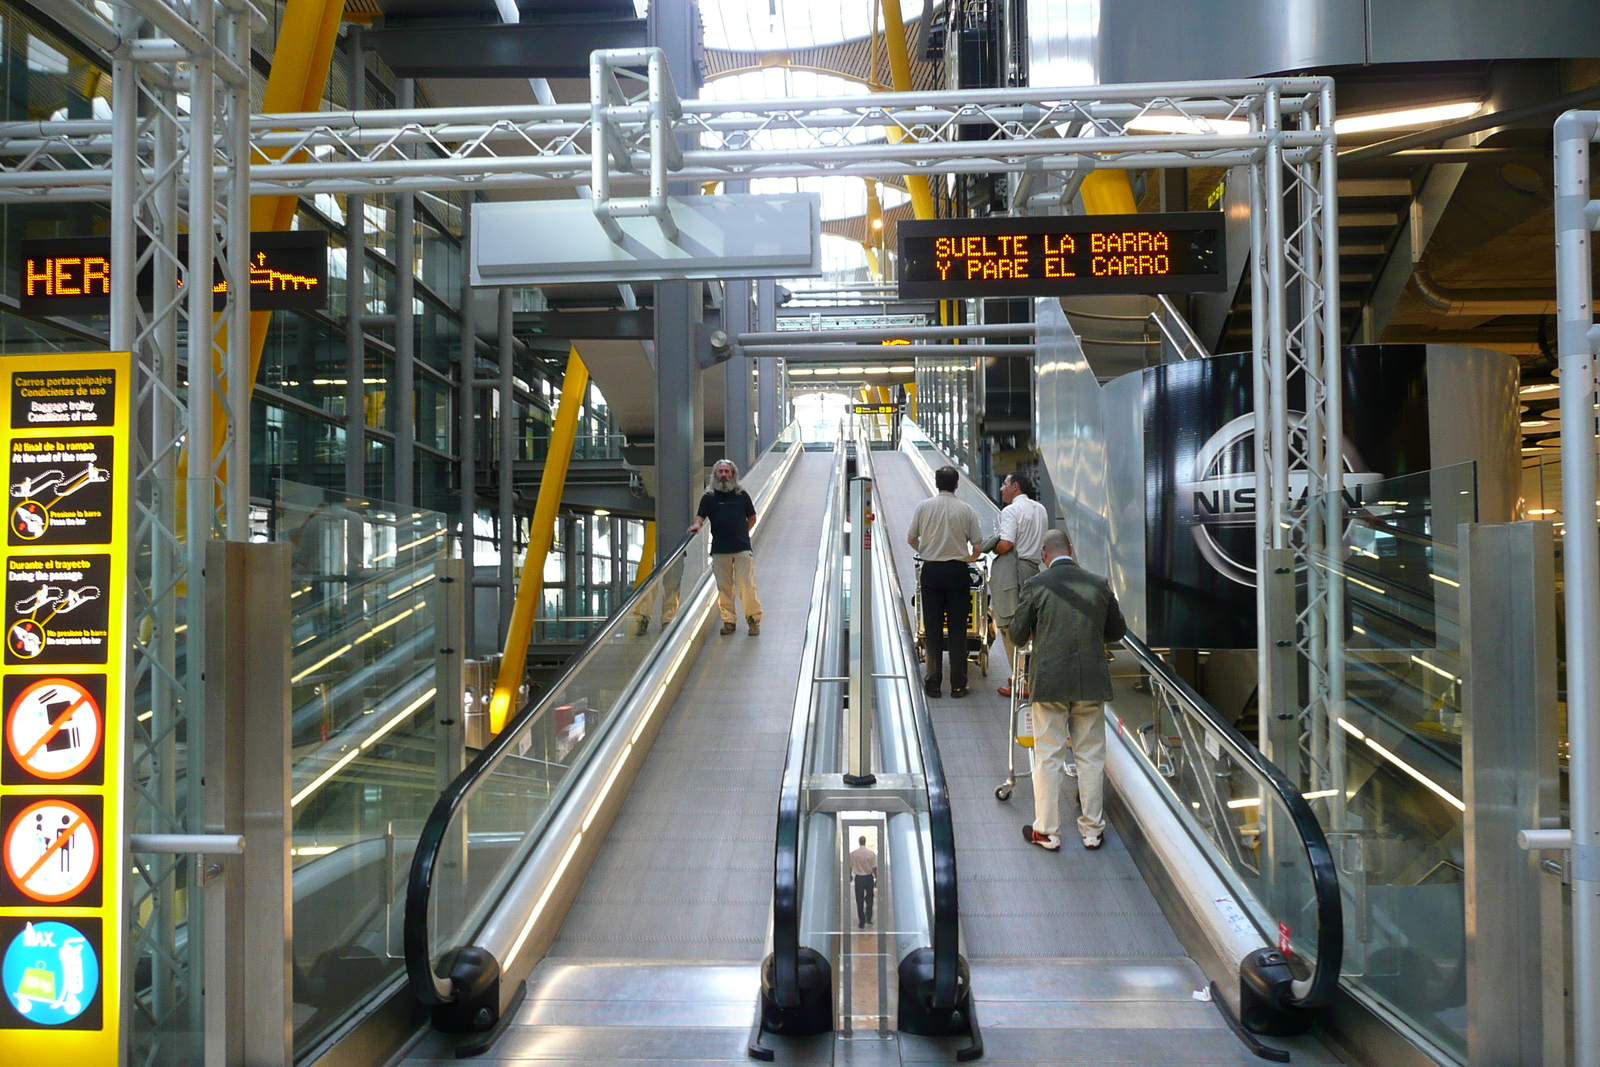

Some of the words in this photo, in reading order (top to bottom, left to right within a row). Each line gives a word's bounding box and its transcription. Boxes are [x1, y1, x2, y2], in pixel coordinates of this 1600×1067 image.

[936, 235, 1028, 257] SUELTE
[1045, 234, 1075, 254] LA
[1091, 231, 1169, 253] BARRA
[936, 259, 950, 280] Y
[967, 258, 1029, 279] PARE
[1045, 257, 1075, 277] EL
[1091, 254, 1169, 276] CARRO
[15, 377, 45, 386] Carros
[47, 375, 112, 387] portaequipajes
[21, 386, 74, 397] Condiciones
[76, 386, 88, 396] de
[90, 387, 106, 395] uso
[31, 401, 68, 413] Baggage
[69, 400, 95, 411] trolley
[28, 411, 70, 422] Conditions
[71, 410, 81, 421] of
[82, 412, 98, 421] use
[13, 443, 22, 452] Al
[24, 442, 42, 451] final
[44, 442, 55, 451] de
[56, 442, 65, 450] la
[66, 443, 94, 451] rampa
[12, 453, 22, 463] At
[23, 453, 35, 462] the
[36, 453, 51, 462] end
[52, 452, 61, 462] of
[62, 452, 75, 461] the
[1193, 484, 1364, 516] NISAN
[9, 560, 43, 569] Durante
[45, 560, 53, 569] el
[55, 560, 90, 570] trayecto
[8, 571, 35, 582] During
[35, 571, 48, 580] the
